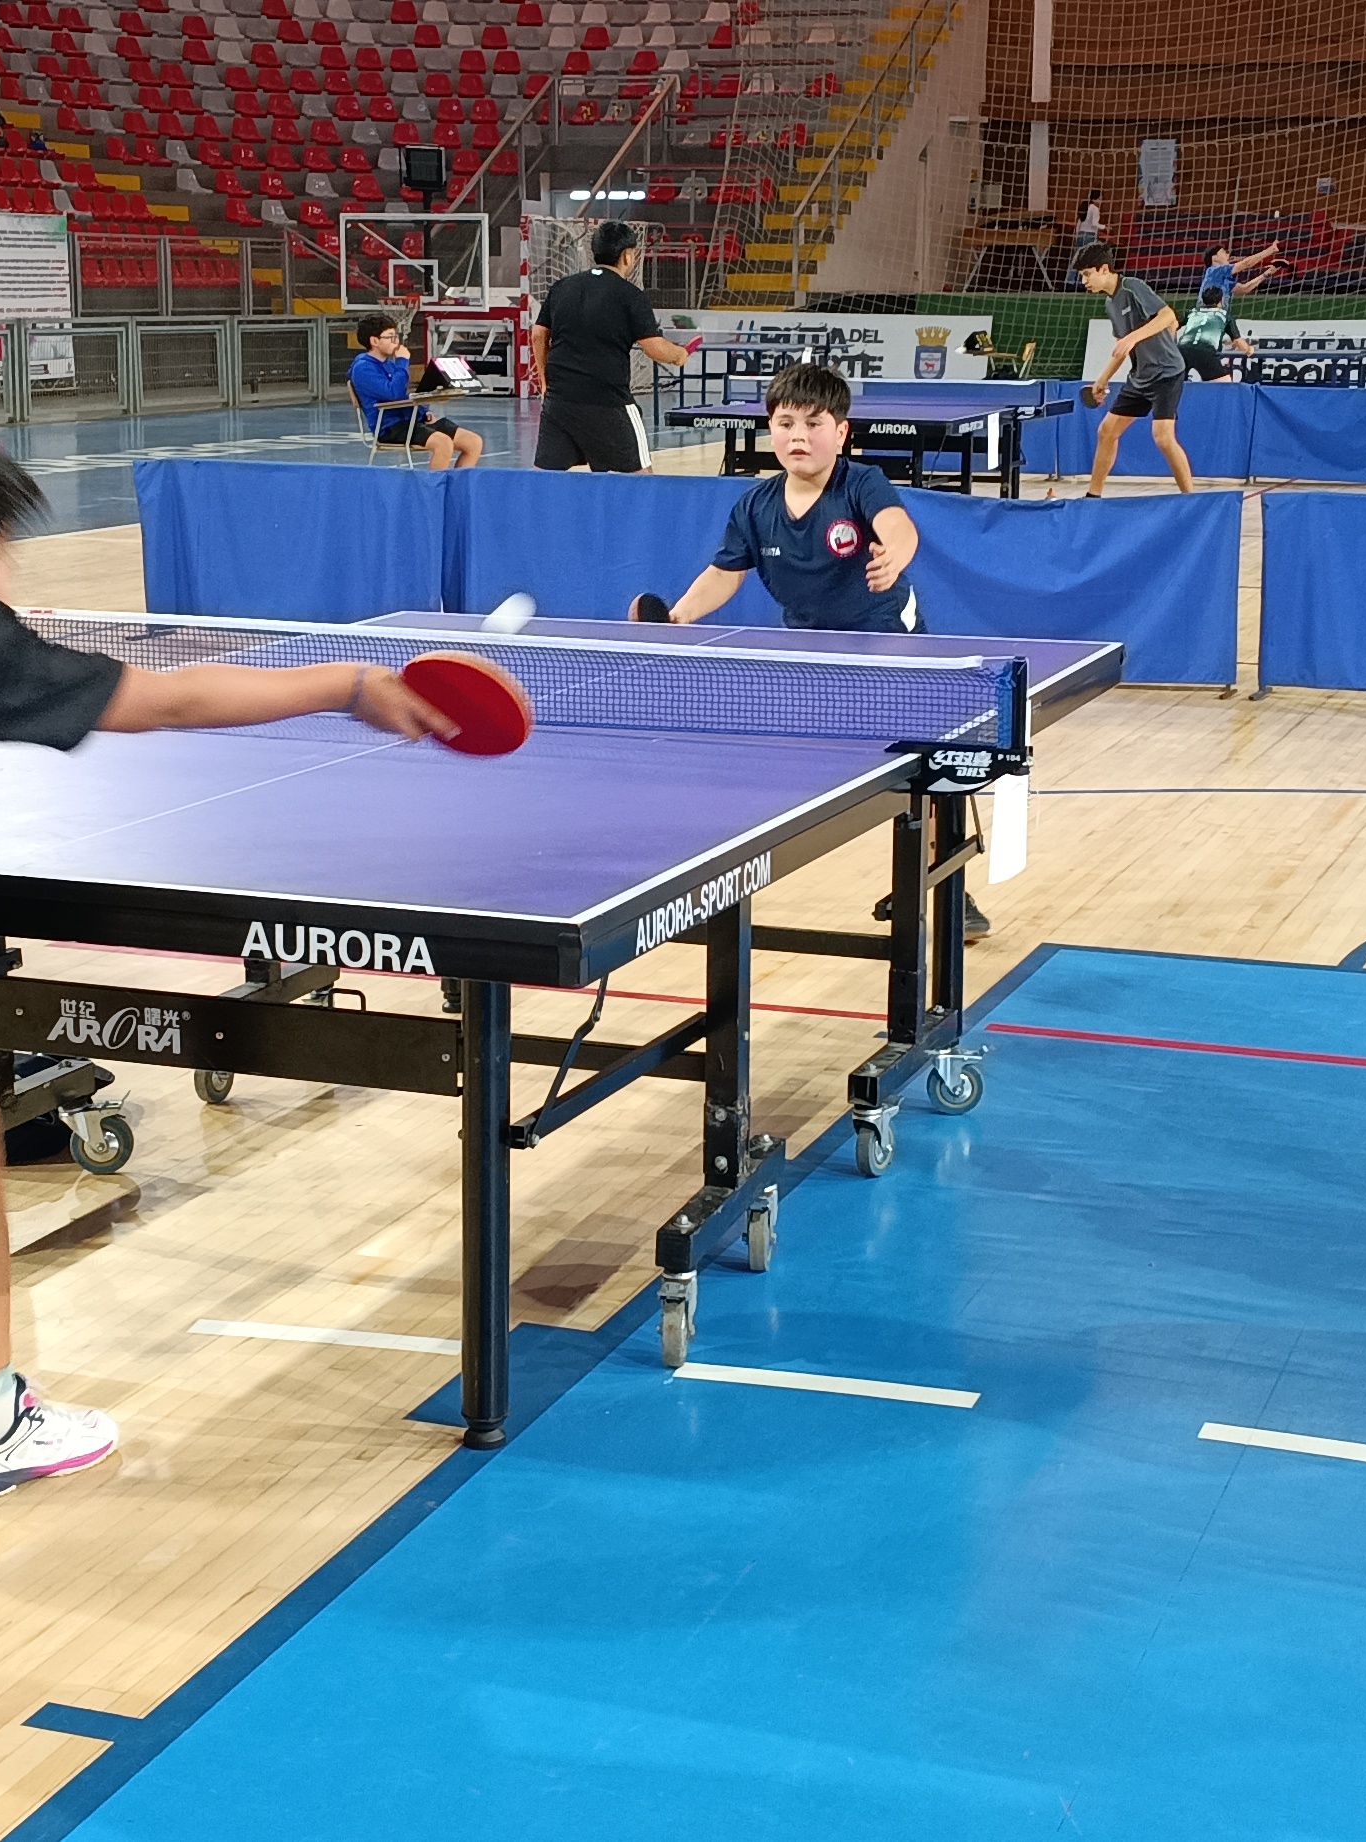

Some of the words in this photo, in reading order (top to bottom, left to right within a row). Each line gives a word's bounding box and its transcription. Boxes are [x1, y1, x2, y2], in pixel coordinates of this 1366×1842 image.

[848, 328, 884, 344] DEL
[693, 417, 756, 430] COMPETITION
[868, 422, 918, 436] AURORA
[635, 850, 772, 957] AURORA-SPORT.COM
[240, 921, 436, 976] AURORA
[60, 998, 96, 1020] 世纪
